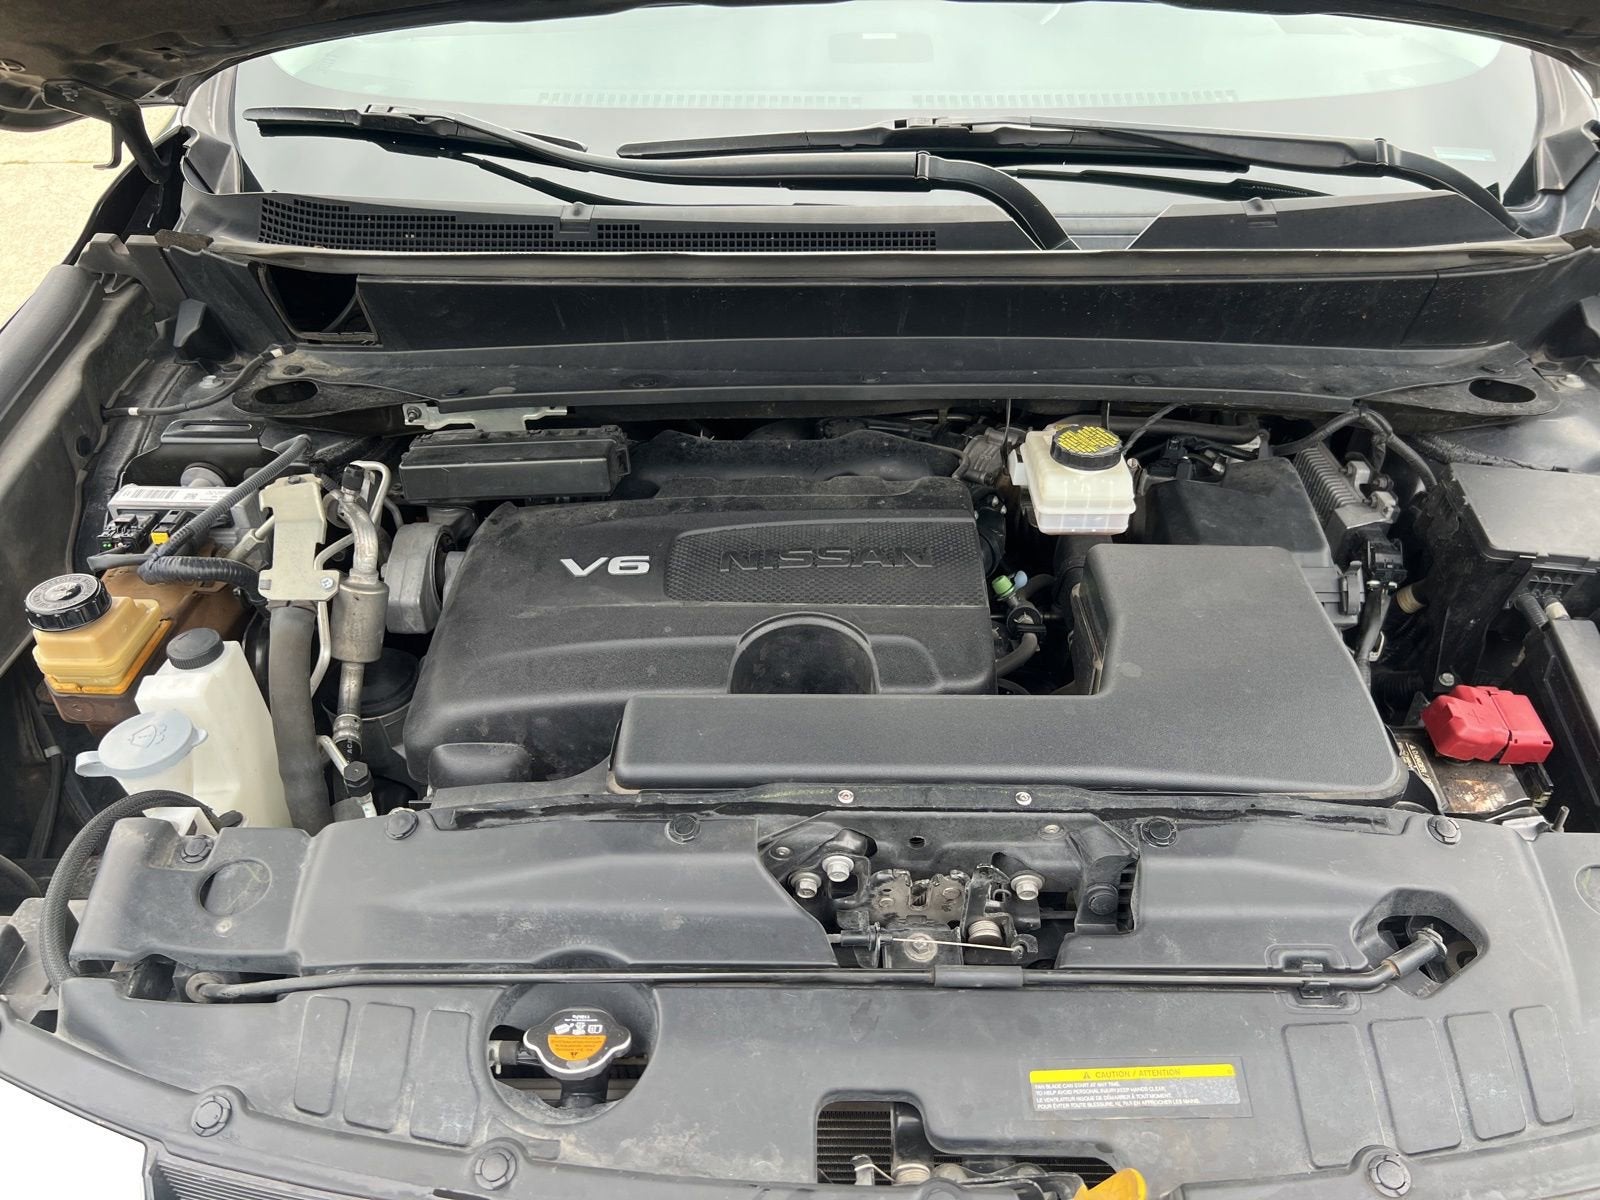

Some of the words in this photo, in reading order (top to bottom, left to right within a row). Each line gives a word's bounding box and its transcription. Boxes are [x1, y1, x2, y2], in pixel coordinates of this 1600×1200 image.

[560, 555, 650, 577] V6
[720, 546, 933, 572] NISSAN
[1095, 1071, 1131, 1079] CAUTION
[1139, 1069, 1181, 1077] ATTENTION
